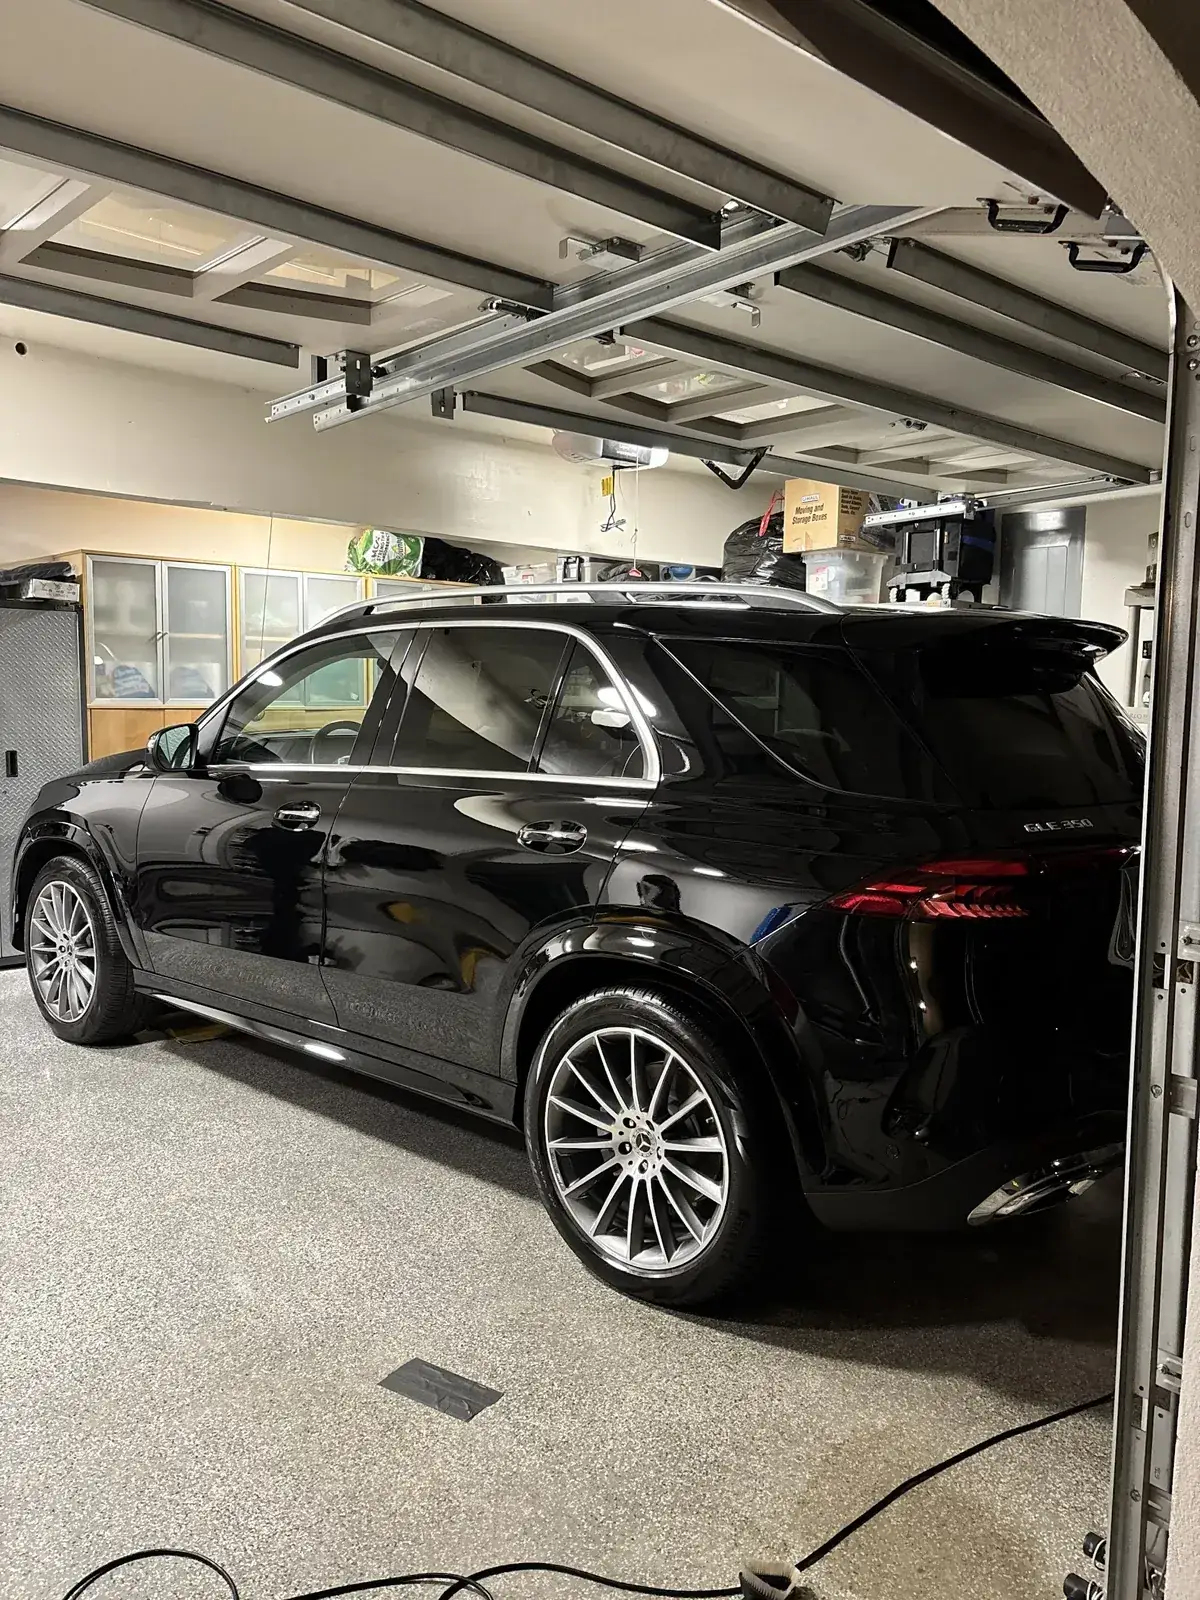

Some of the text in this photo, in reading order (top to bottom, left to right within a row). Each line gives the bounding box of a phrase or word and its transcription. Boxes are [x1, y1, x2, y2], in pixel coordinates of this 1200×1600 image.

[795, 503, 824, 515] Moving and
[792, 513, 827, 525] Storage Boxes
[1023, 818, 1094, 833] GLE 350
